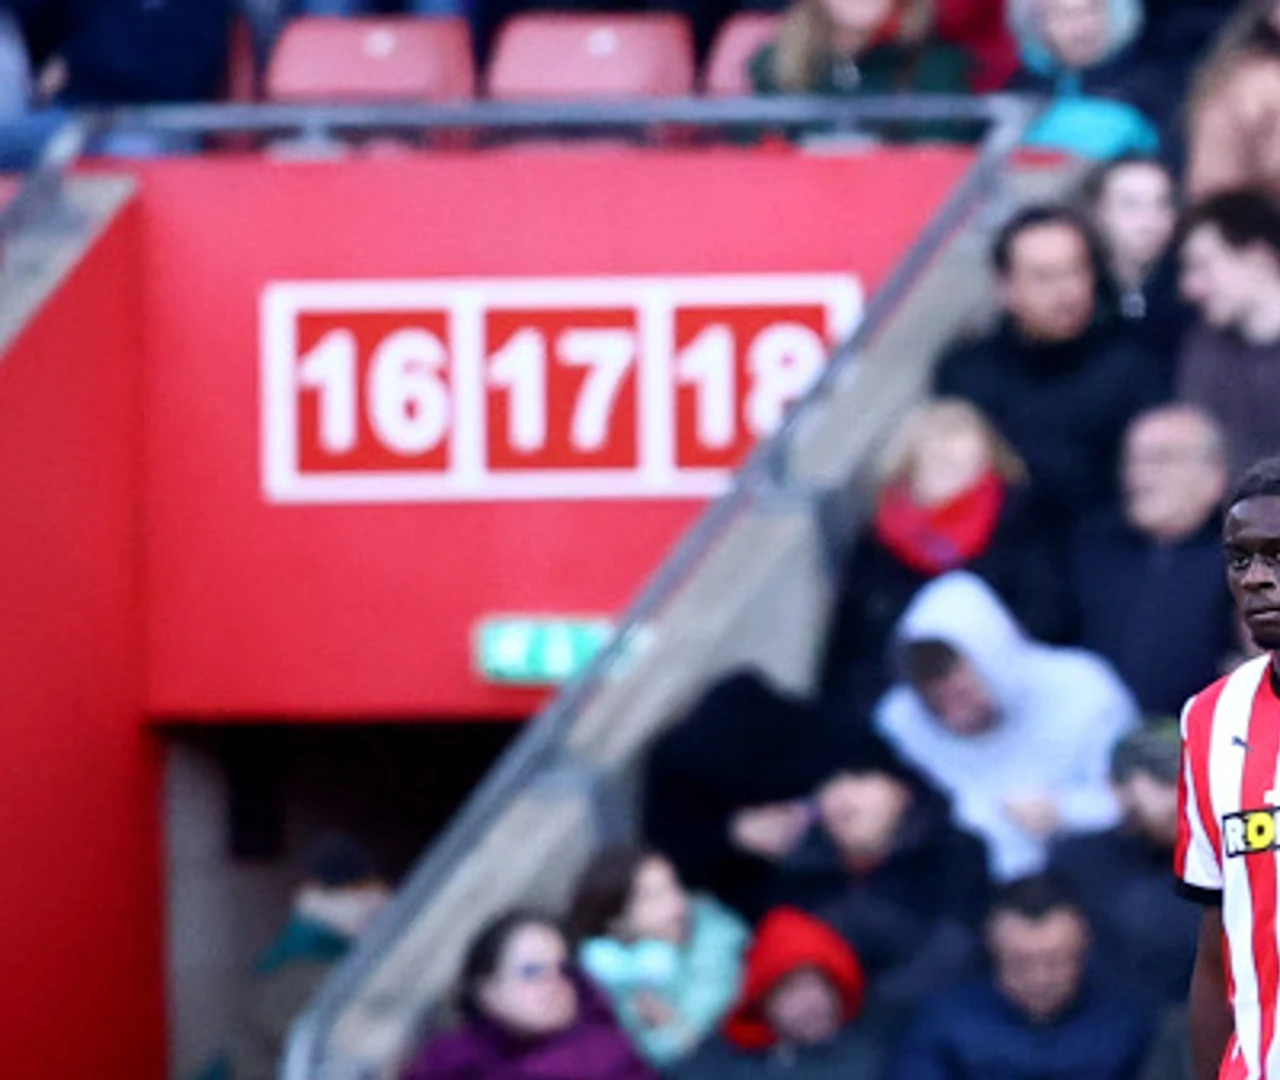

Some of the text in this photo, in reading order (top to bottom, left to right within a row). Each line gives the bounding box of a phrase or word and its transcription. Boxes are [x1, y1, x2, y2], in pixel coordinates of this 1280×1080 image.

[298, 321, 830, 455] 16 17 18
